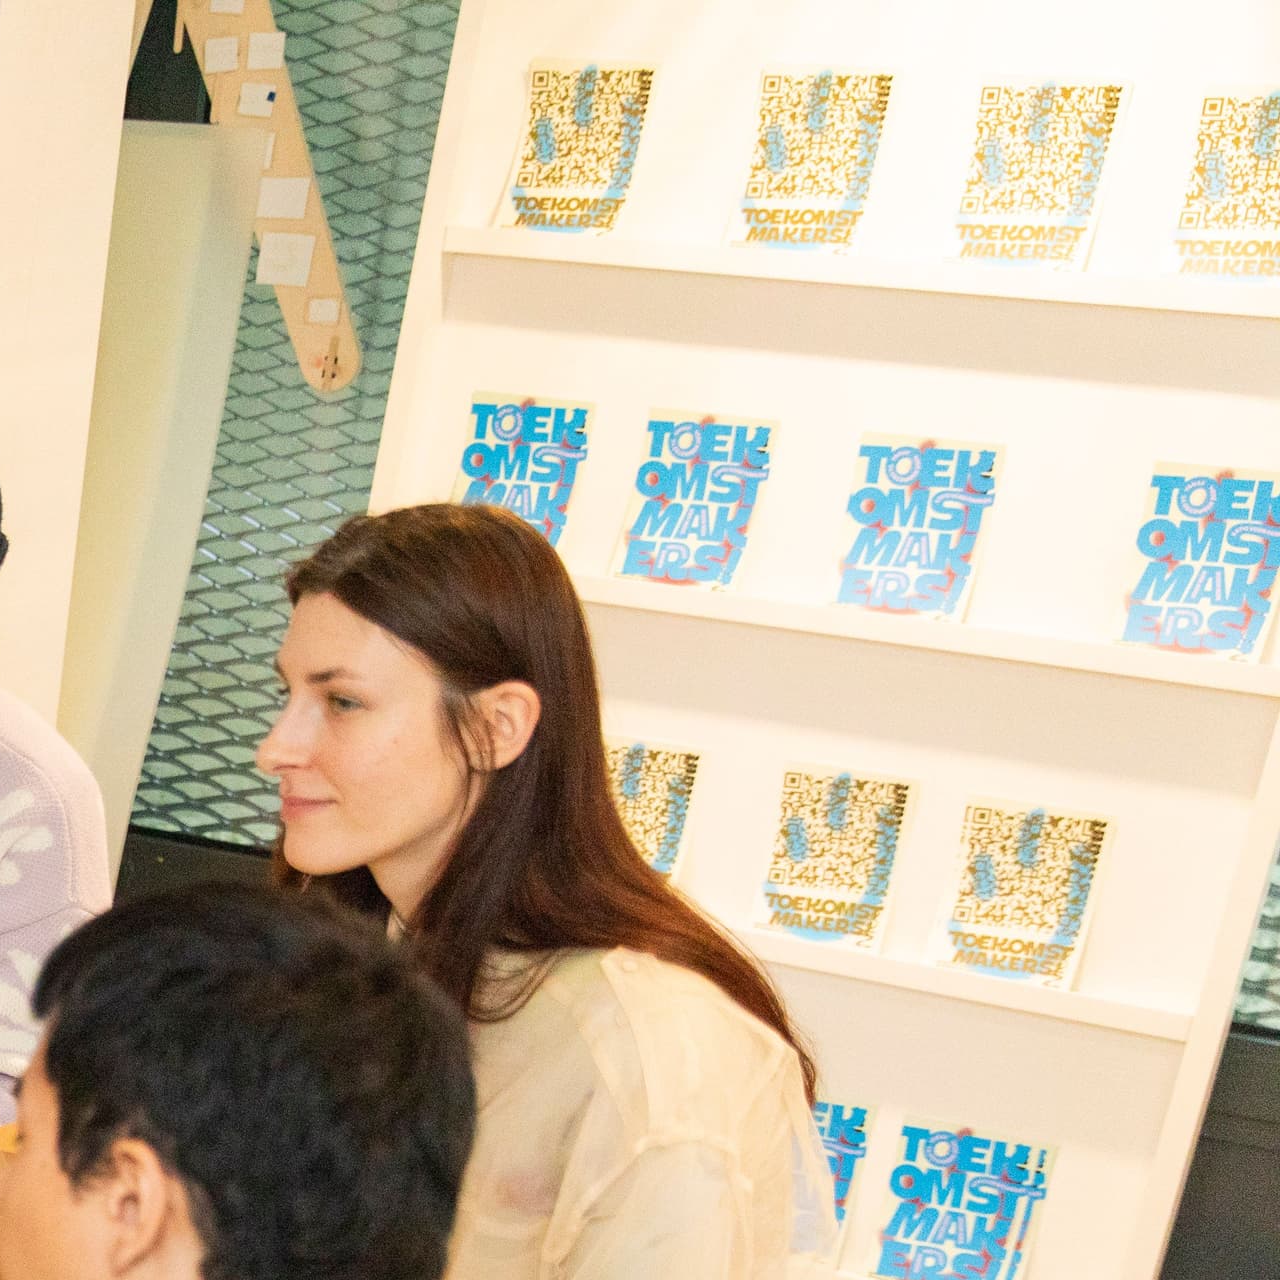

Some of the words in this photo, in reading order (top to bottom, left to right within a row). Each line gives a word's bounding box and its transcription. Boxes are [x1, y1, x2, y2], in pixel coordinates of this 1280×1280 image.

[512, 196, 626, 213] TOEKOMST
[514, 212, 614, 228] MAKERS!
[742, 208, 864, 226] TOEKOMST
[746, 227, 852, 243] MAKERS!
[955, 224, 1087, 241] TOEKOMST
[959, 242, 1073, 260] MAKERS!
[1174, 239, 1280, 257] TOEKOM
[470, 403, 588, 447] TOEK
[647, 420, 771, 467] TOEK
[461, 442, 588, 485] OMST
[635, 461, 770, 508] OMST
[858, 445, 996, 493] TOEK
[630, 500, 753, 548] MAK
[846, 487, 995, 534] OMST
[844, 527, 977, 576] MAK
[1130, 561, 1278, 614] MAK
[764, 892, 884, 920] TOEKOMST
[948, 931, 1075, 961] TOEKOMST
[883, 1202, 1012, 1260] MAK
